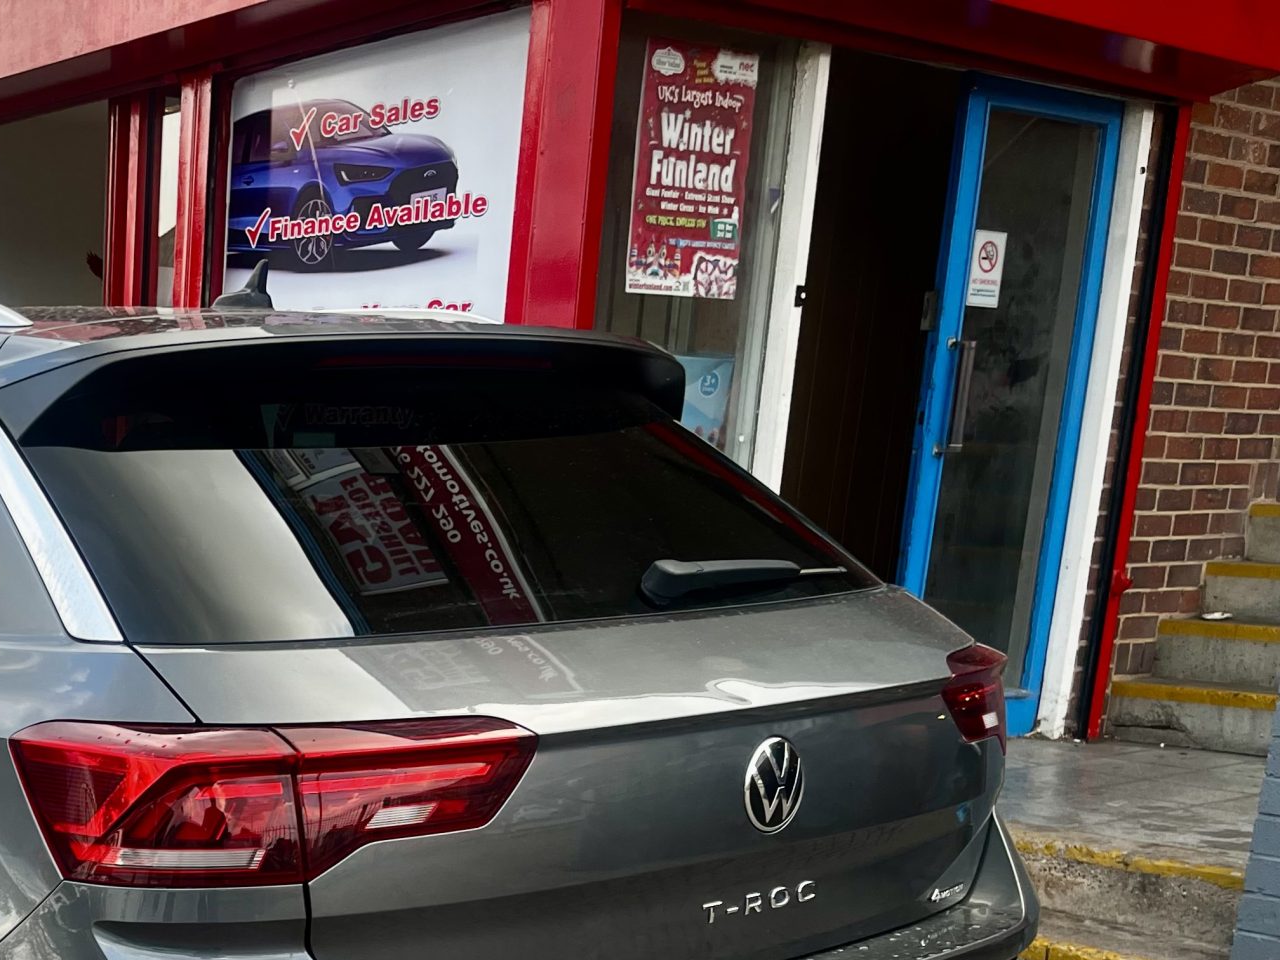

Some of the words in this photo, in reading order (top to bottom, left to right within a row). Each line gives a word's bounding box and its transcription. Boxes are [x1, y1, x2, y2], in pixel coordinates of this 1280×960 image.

[320, 110, 362, 138] Car
[369, 97, 440, 128] Sales
[681, 86, 712, 109] Largest
[715, 92, 742, 113] Indoor
[660, 110, 736, 155] Winter
[649, 149, 737, 193] Funland
[269, 210, 360, 242] Finance
[366, 192, 488, 230] Available
[703, 880, 817, 924] T-ROC
